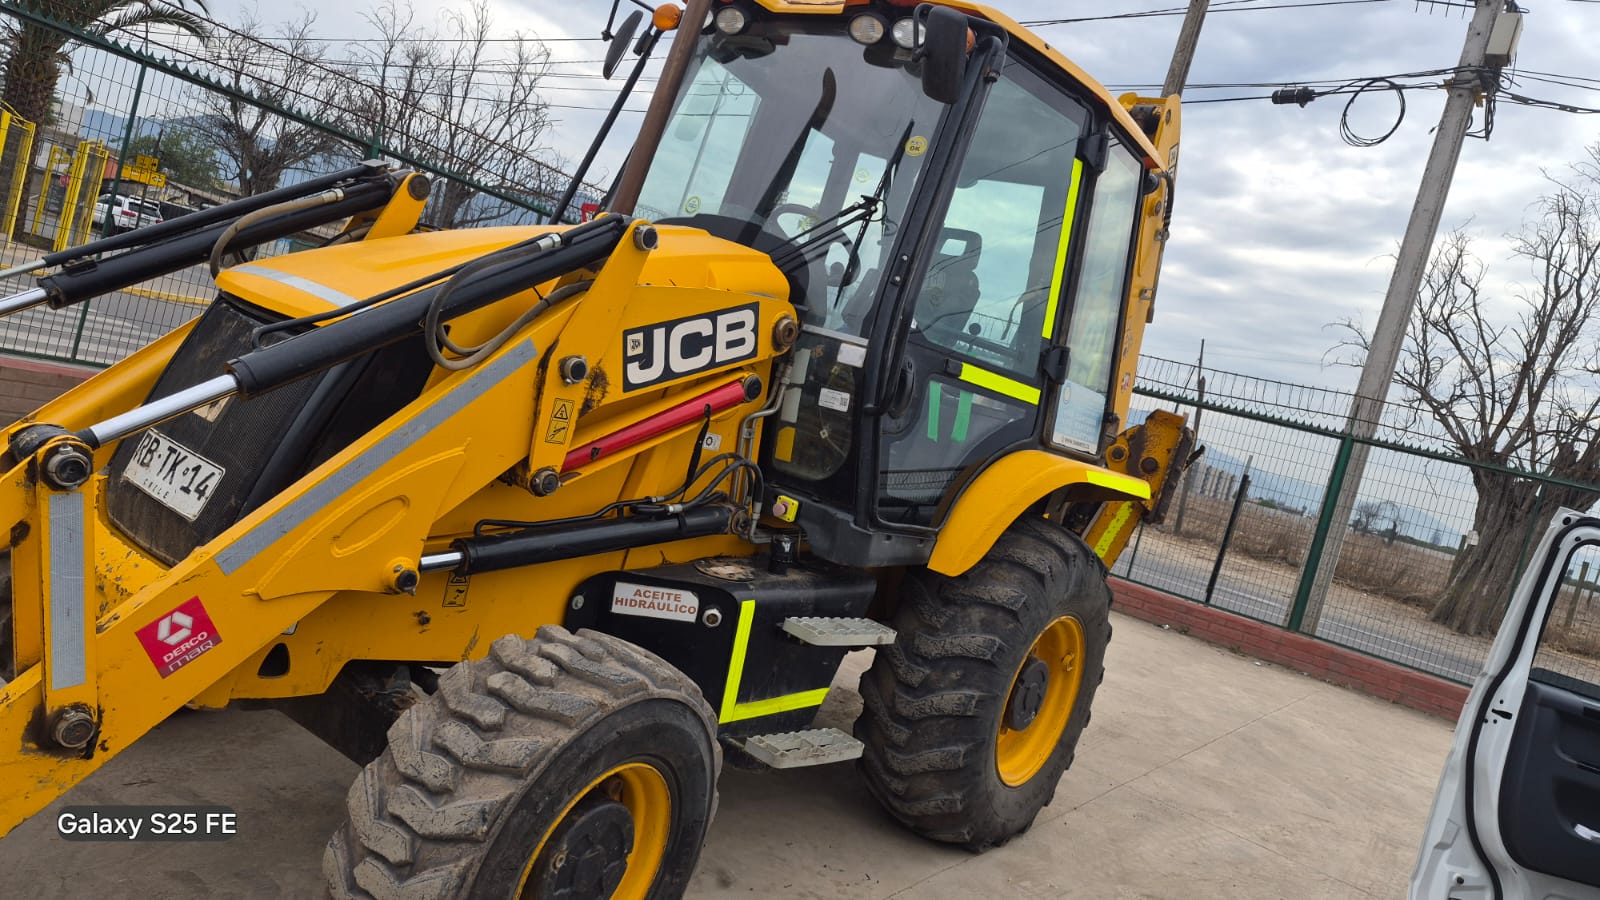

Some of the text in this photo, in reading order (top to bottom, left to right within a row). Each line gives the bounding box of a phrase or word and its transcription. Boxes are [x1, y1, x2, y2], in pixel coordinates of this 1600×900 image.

[627, 309, 756, 384] JCB
[614, 596, 697, 615] HIDRÁULICO
[633, 588, 683, 603] ACEITE
[163, 631, 208, 663] DERCO
